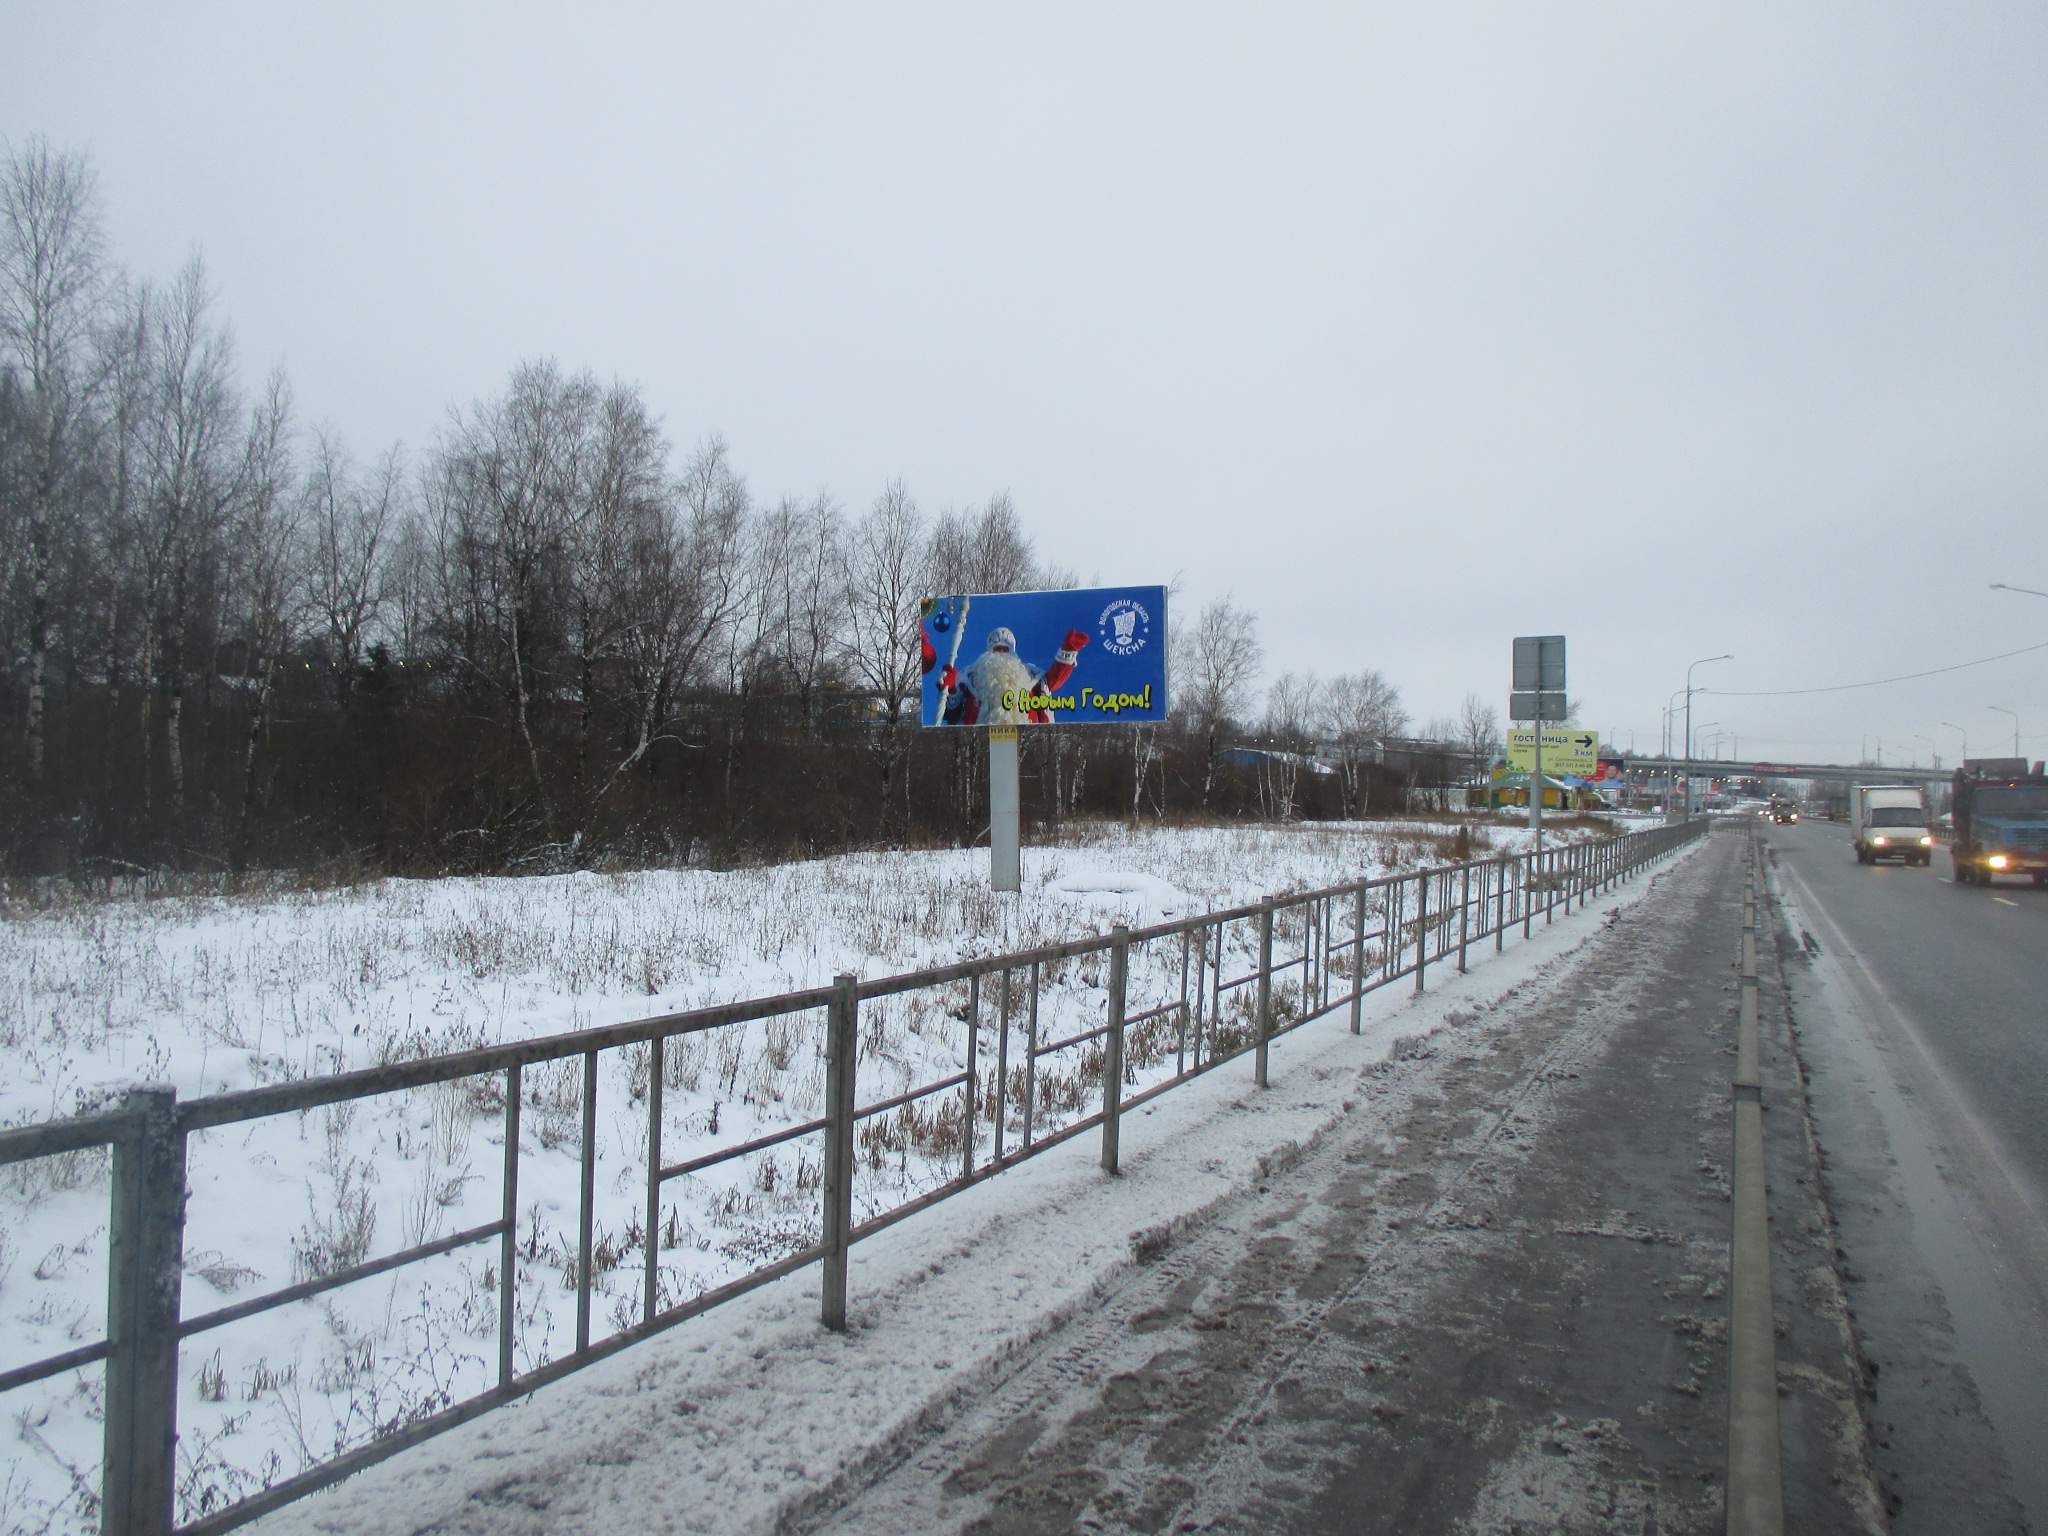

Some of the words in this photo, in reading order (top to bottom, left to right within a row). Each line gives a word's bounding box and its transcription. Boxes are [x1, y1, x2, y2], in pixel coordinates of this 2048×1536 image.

[1098, 599, 1131, 626] ВОЛОГОДСКАЯ
[1131, 601, 1150, 624] ОБЛАСТЬ
[1102, 638, 1147, 656] ШЕКСНА
[1002, 690, 1015, 710] С
[1018, 688, 1076, 712] Новым
[1081, 684, 1152, 713] Годом!
[1513, 735, 1569, 743] гостница
[1574, 748, 1579, 756] 3
